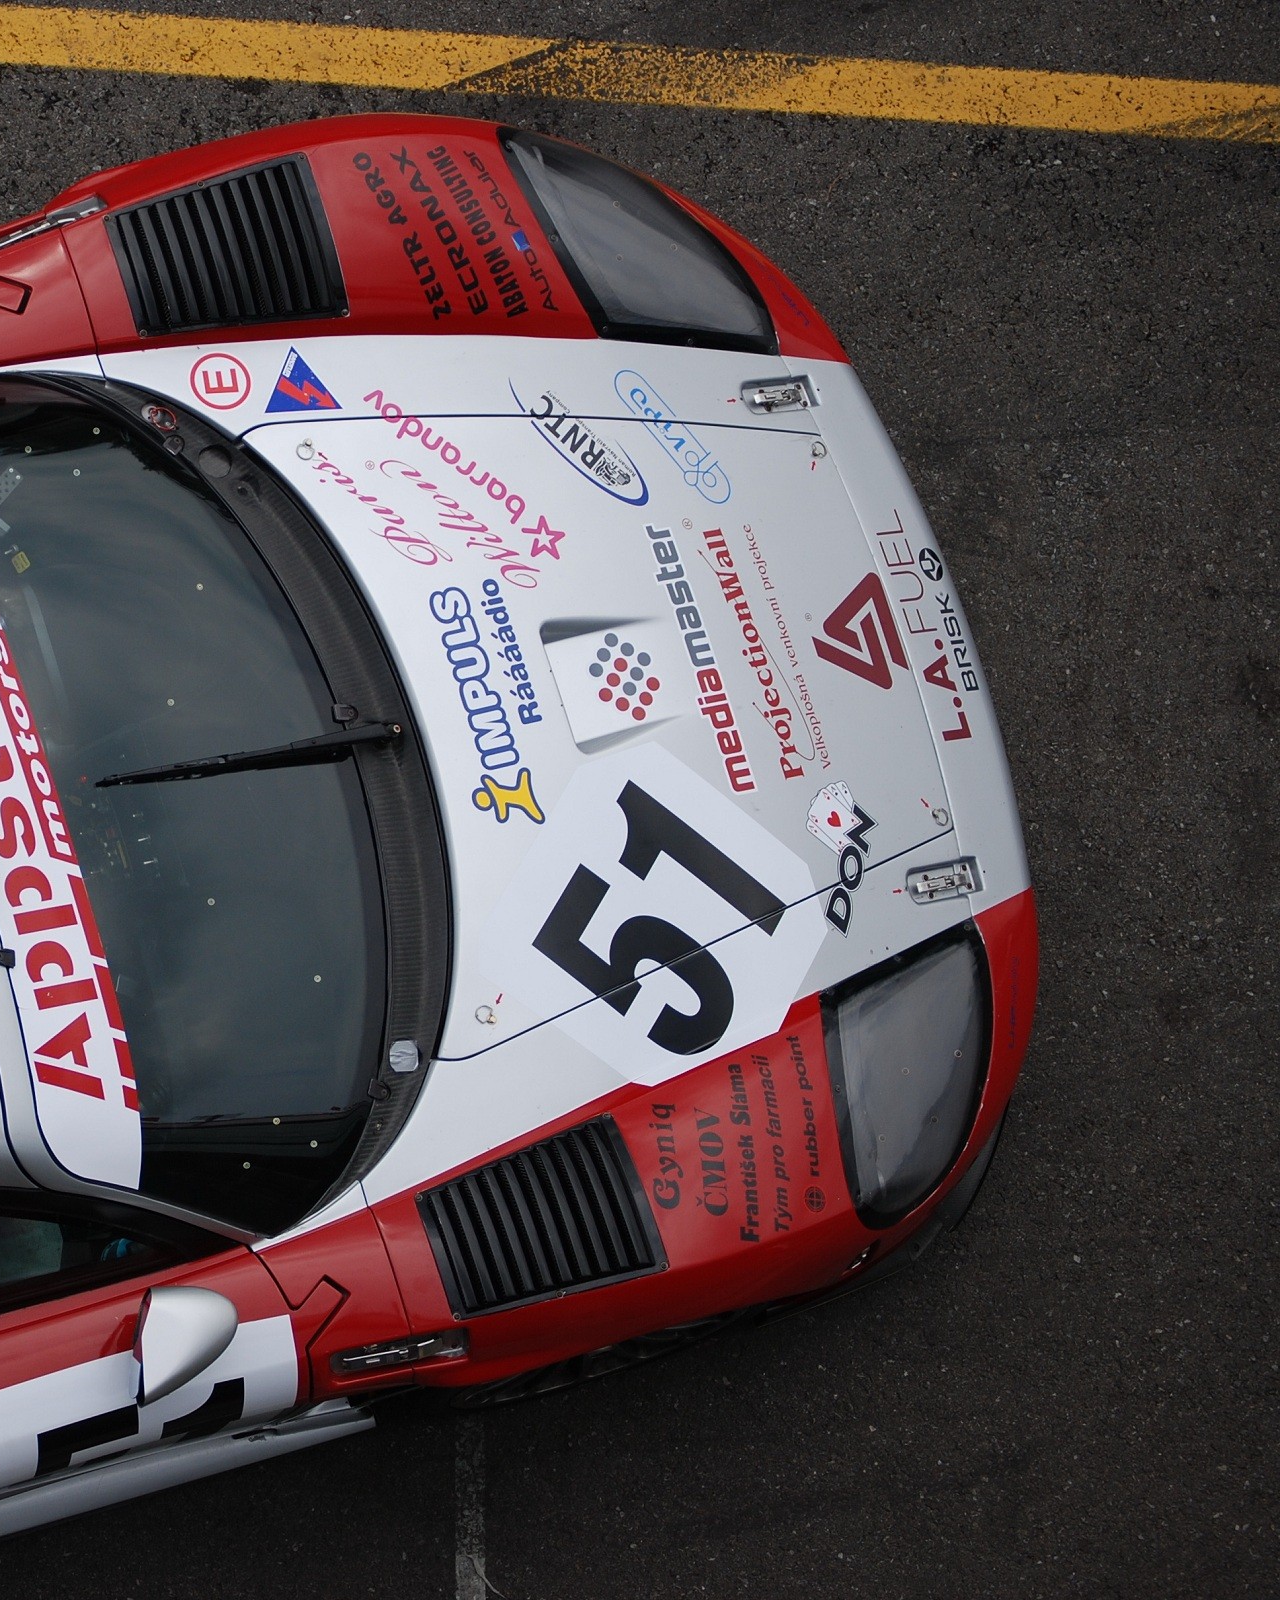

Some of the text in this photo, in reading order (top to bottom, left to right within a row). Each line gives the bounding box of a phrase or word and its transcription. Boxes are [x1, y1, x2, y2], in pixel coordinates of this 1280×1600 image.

[353, 152, 452, 320] ZELTR AGRO
[390, 146, 489, 315] ECRONAX
[427, 145, 529, 318] ABATON CONSULTING
[202, 368, 239, 394] E
[530, 394, 605, 470] RNTC
[363, 389, 526, 525] barrandov
[380, 459, 541, 588] Wilton
[742, 523, 775, 591] projekce
[429, 586, 520, 770] IMPULS
[646, 524, 756, 793] mediamaster
[703, 527, 805, 780] ProjectionWall
[766, 597, 797, 668] venkovní
[935, 592, 980, 692] BRISK
[532, 779, 787, 1056] 51
[825, 802, 878, 938] DON
[649, 1103, 684, 1210] Gyniq
[694, 1106, 729, 1217] ČMOV
[728, 1063, 760, 1243] František Sláma
[751, 1054, 793, 1233] Tým pro farmacii
[786, 1035, 820, 1178] rubber point
